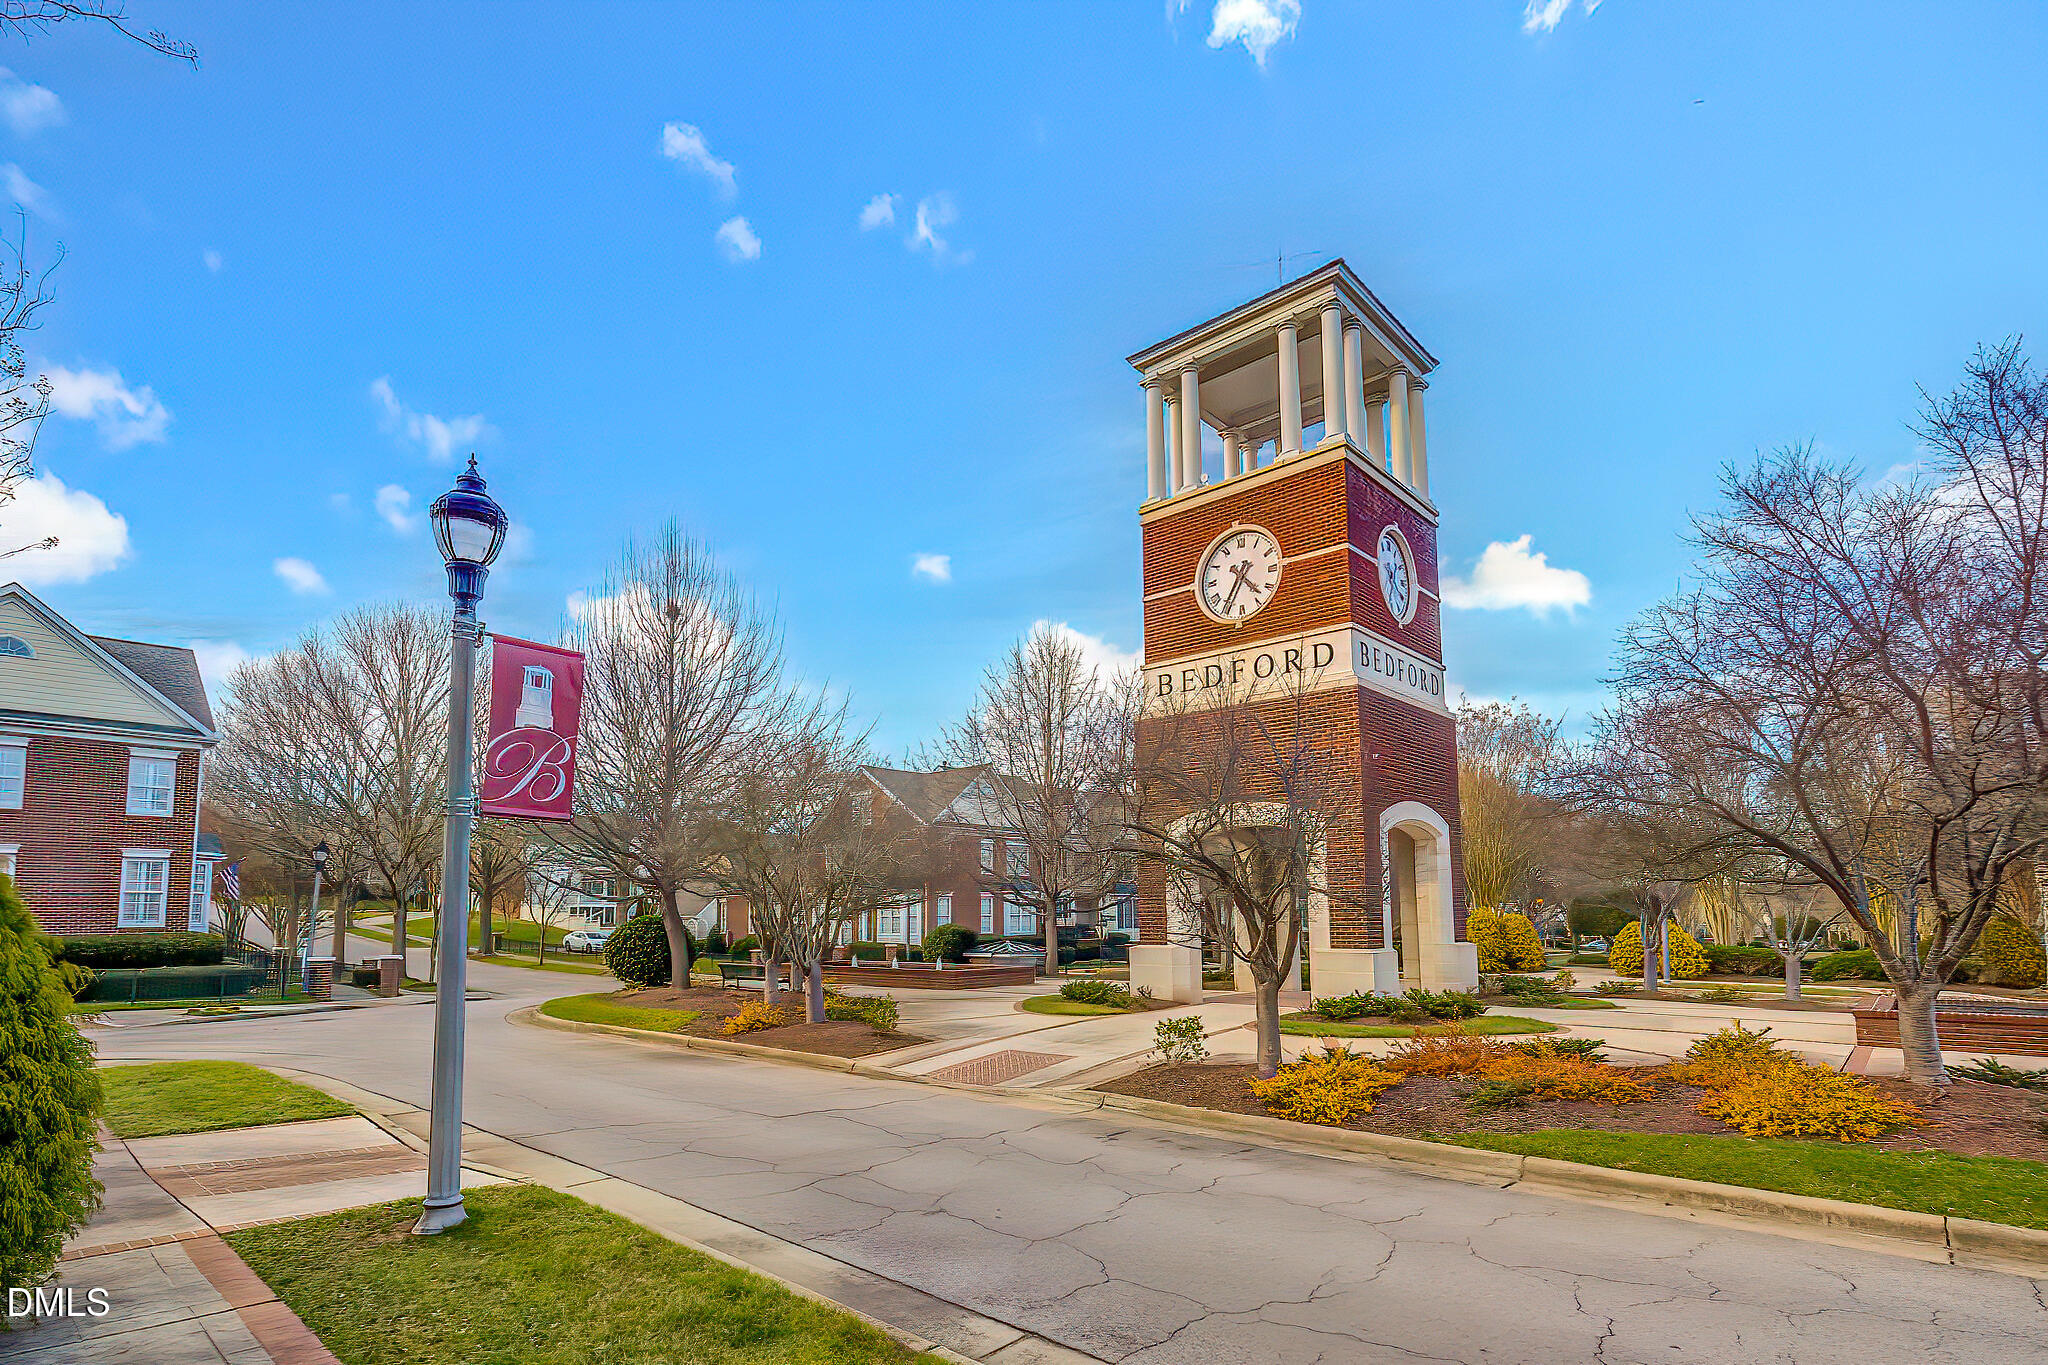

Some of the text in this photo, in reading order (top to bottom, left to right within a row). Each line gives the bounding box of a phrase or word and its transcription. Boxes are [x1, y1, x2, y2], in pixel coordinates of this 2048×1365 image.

[1157, 642, 1334, 697] BEDFORD
[1358, 641, 1439, 697] BEDFORD
[481, 727, 577, 802] B
